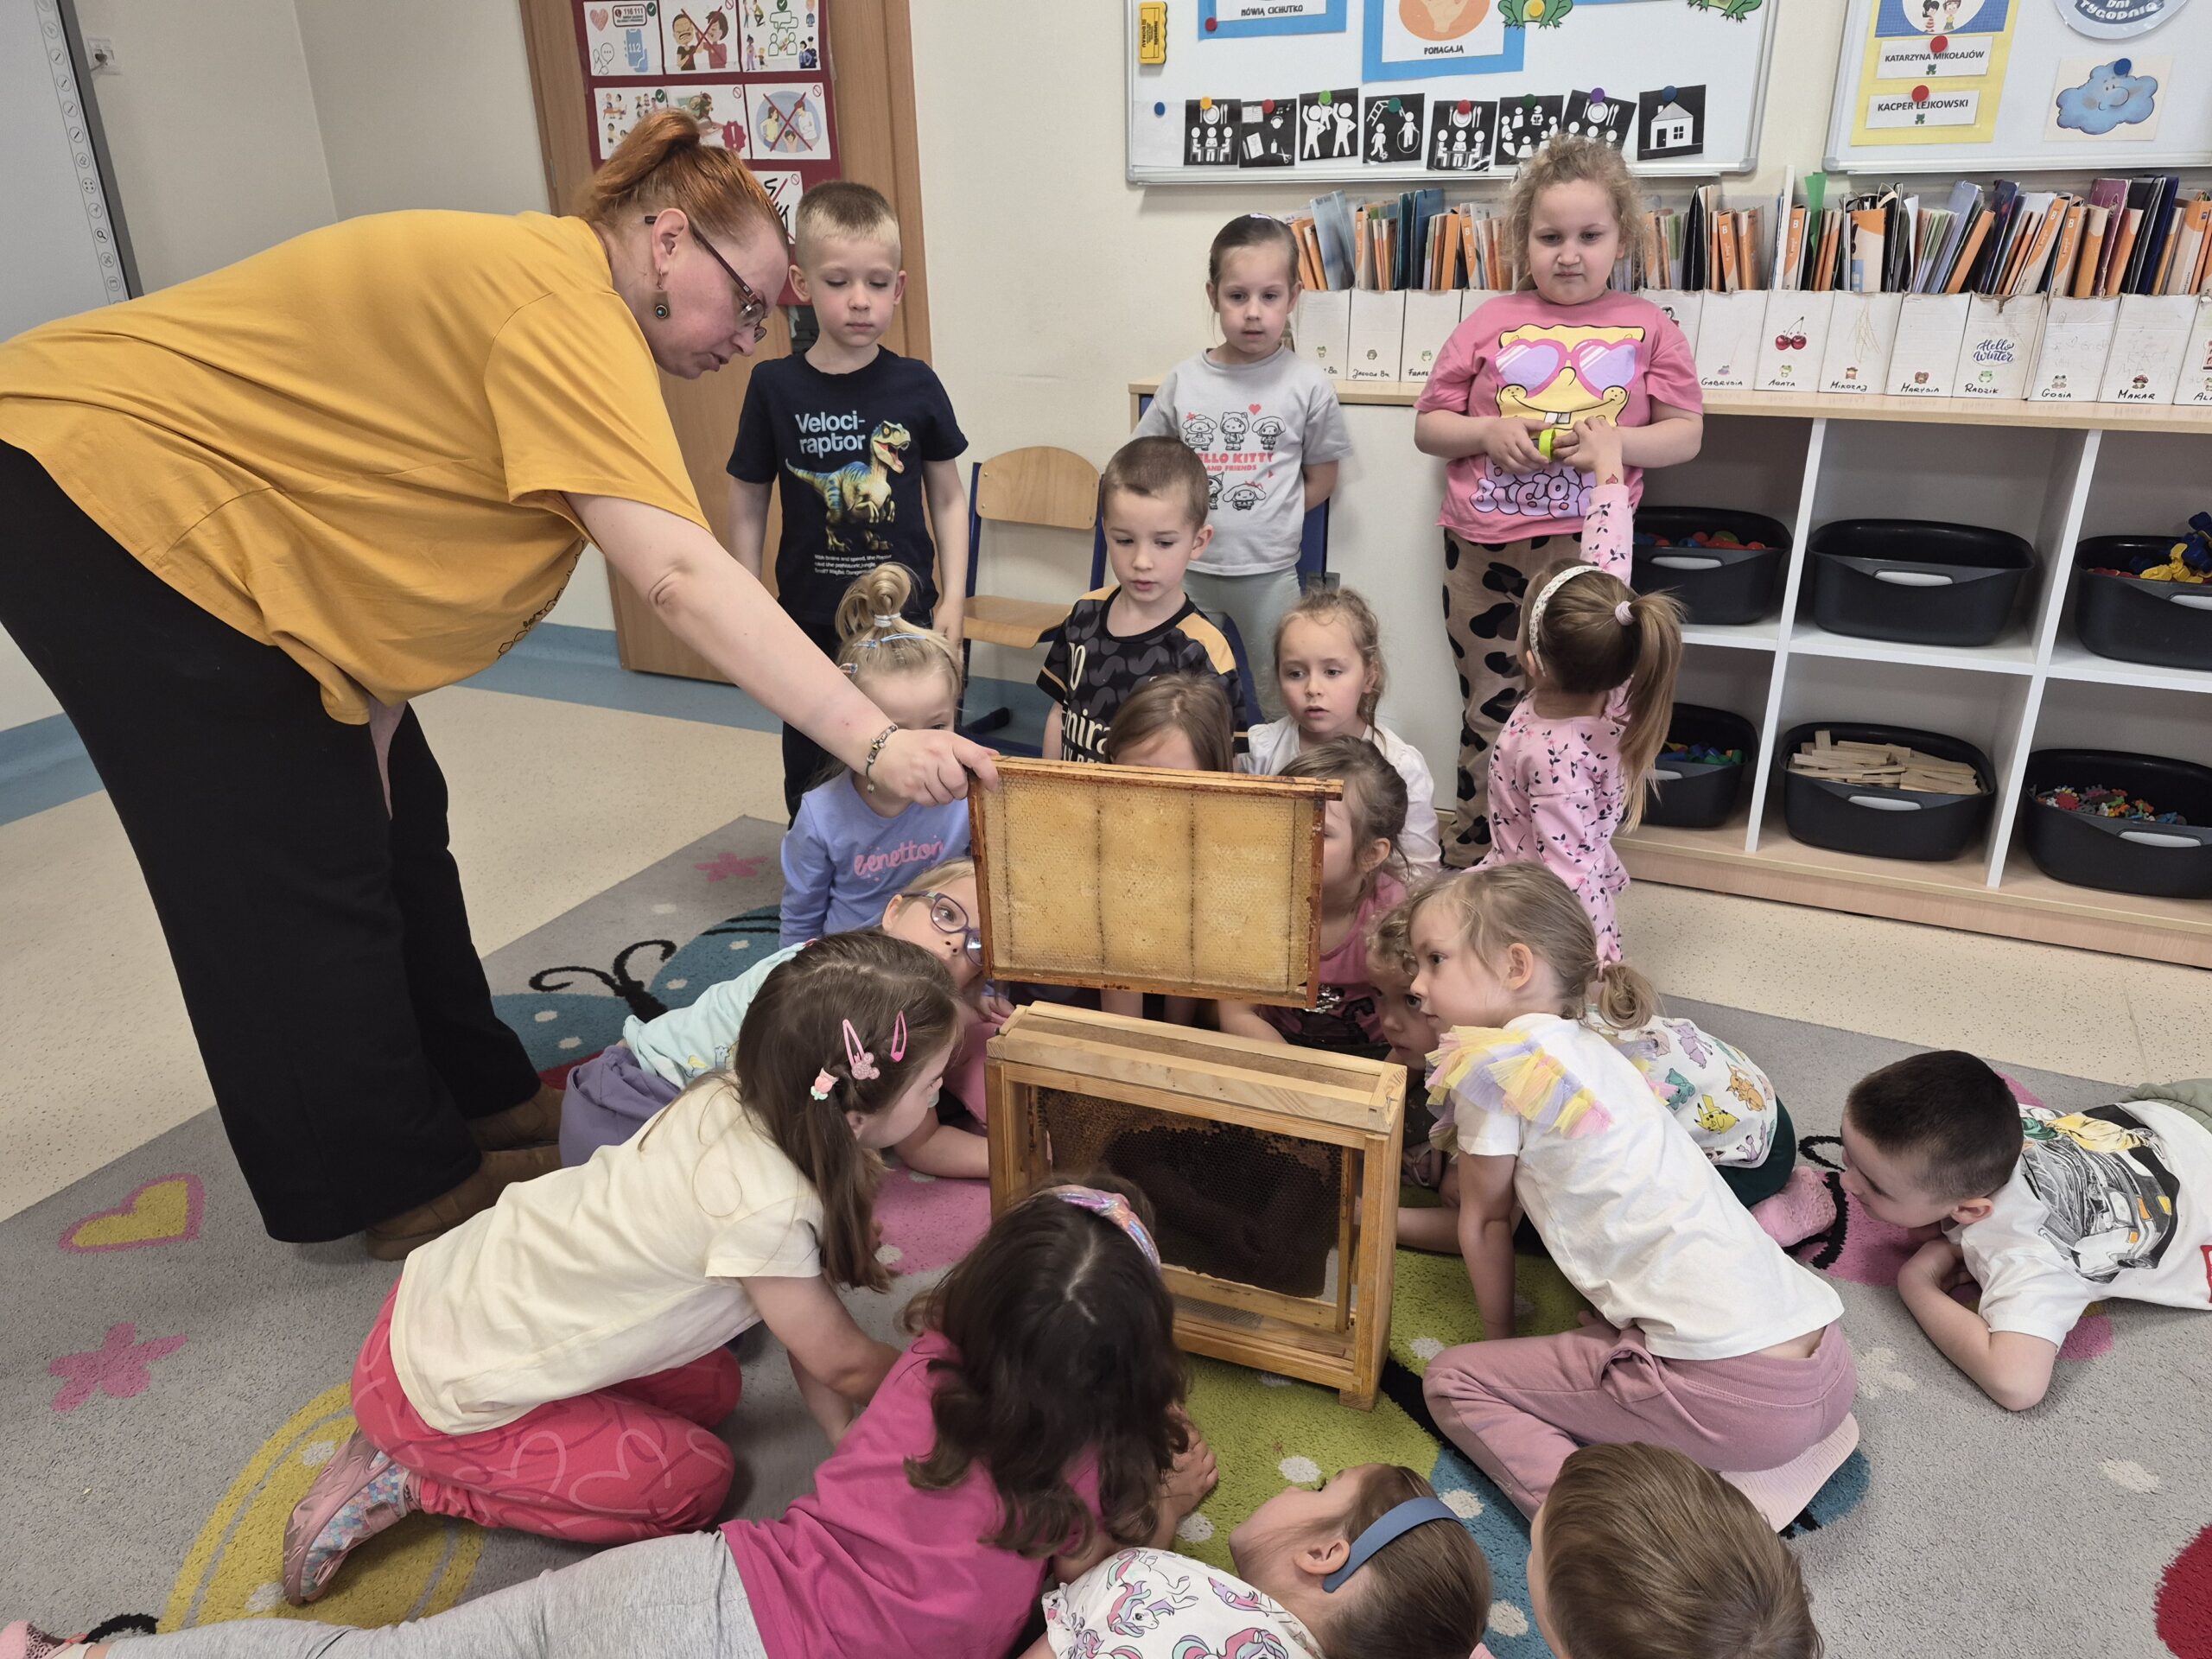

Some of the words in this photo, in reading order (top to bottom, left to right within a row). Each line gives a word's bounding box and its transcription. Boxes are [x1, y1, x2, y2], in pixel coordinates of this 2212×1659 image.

[1268, 4, 1303, 15] CICHUTKO
[628, 43, 641, 53] 112
[1885, 54, 1931, 62] KATARZYNA
[1933, 50, 1985, 60] MIKOŁAJÓW
[1878, 102, 1913, 111] KACPER
[1916, 99, 1968, 110] LEJKOWSKI
[1976, 338, 2015, 352] Hello
[2117, 389, 2156, 400] MAKAR
[795, 410, 866, 434] Veloci-
[799, 432, 866, 459] raptor
[1198, 453, 1229, 463] LLO
[1232, 452, 1274, 463] KITTY
[854, 840, 944, 876] benetton
